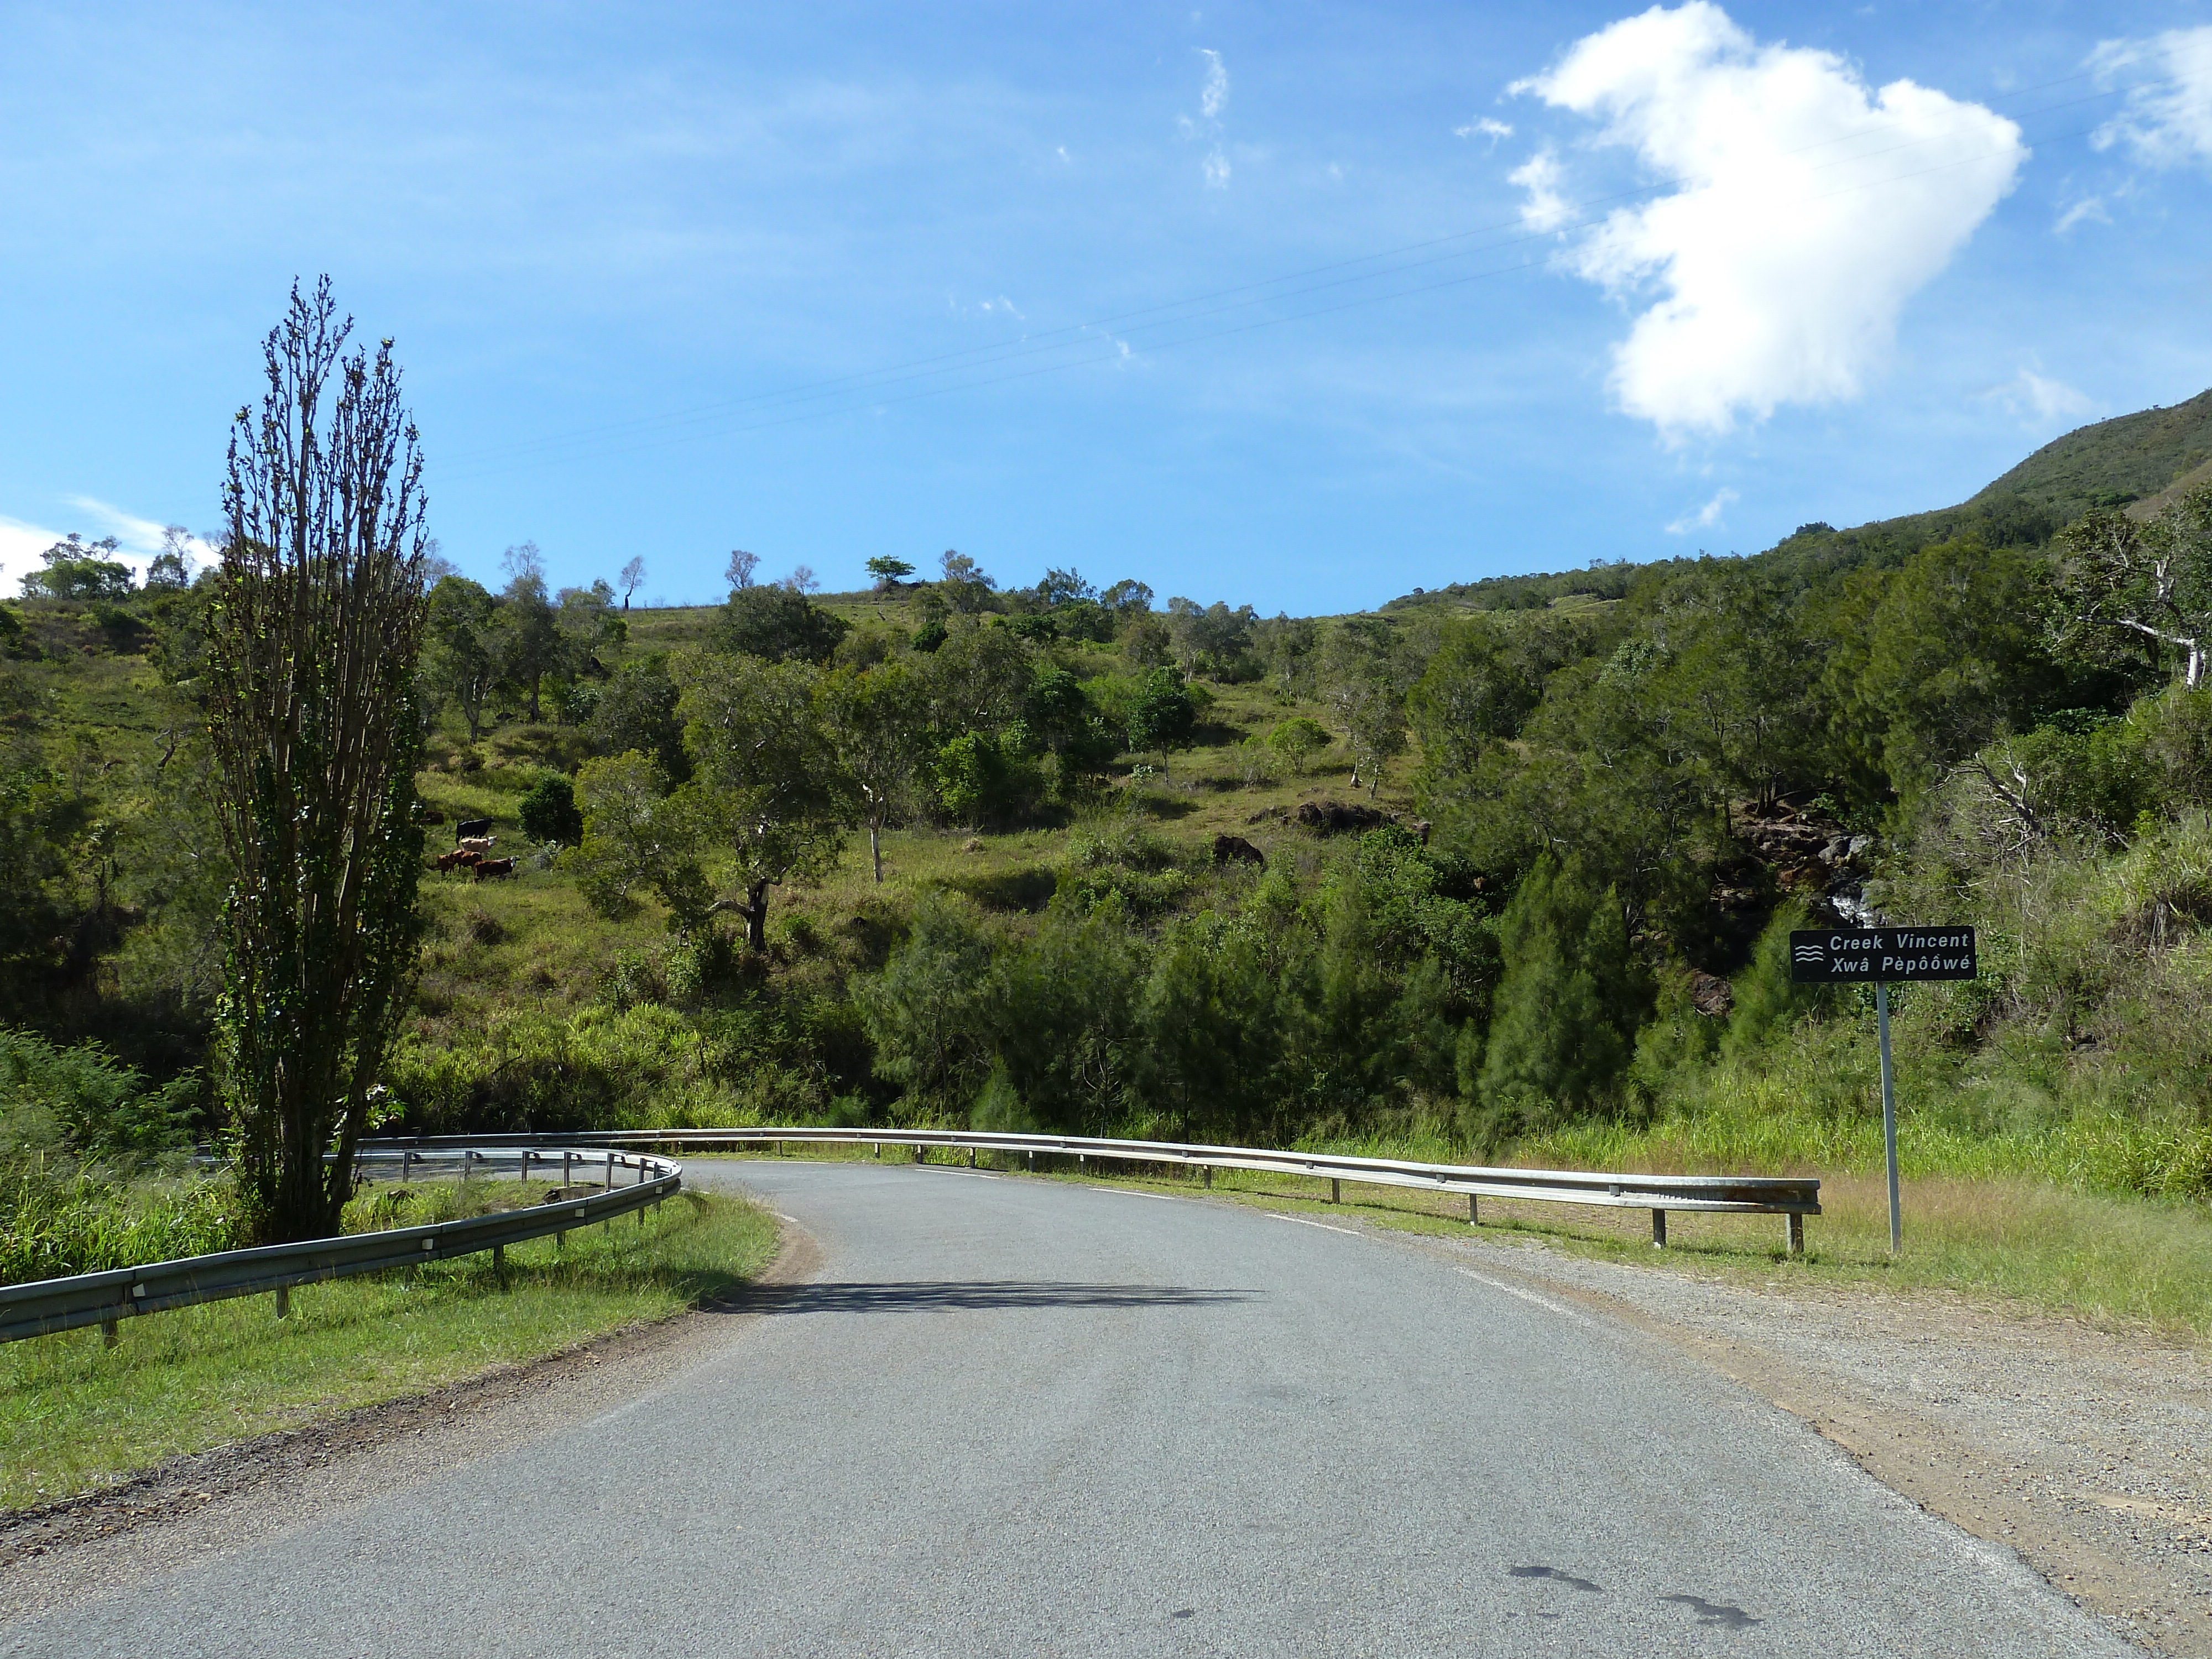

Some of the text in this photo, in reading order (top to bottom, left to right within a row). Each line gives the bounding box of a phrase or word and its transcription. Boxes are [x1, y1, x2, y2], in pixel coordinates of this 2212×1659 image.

[1829, 933, 1969, 951] Creek Vincent
[1830, 958, 1870, 973] Xwâ
